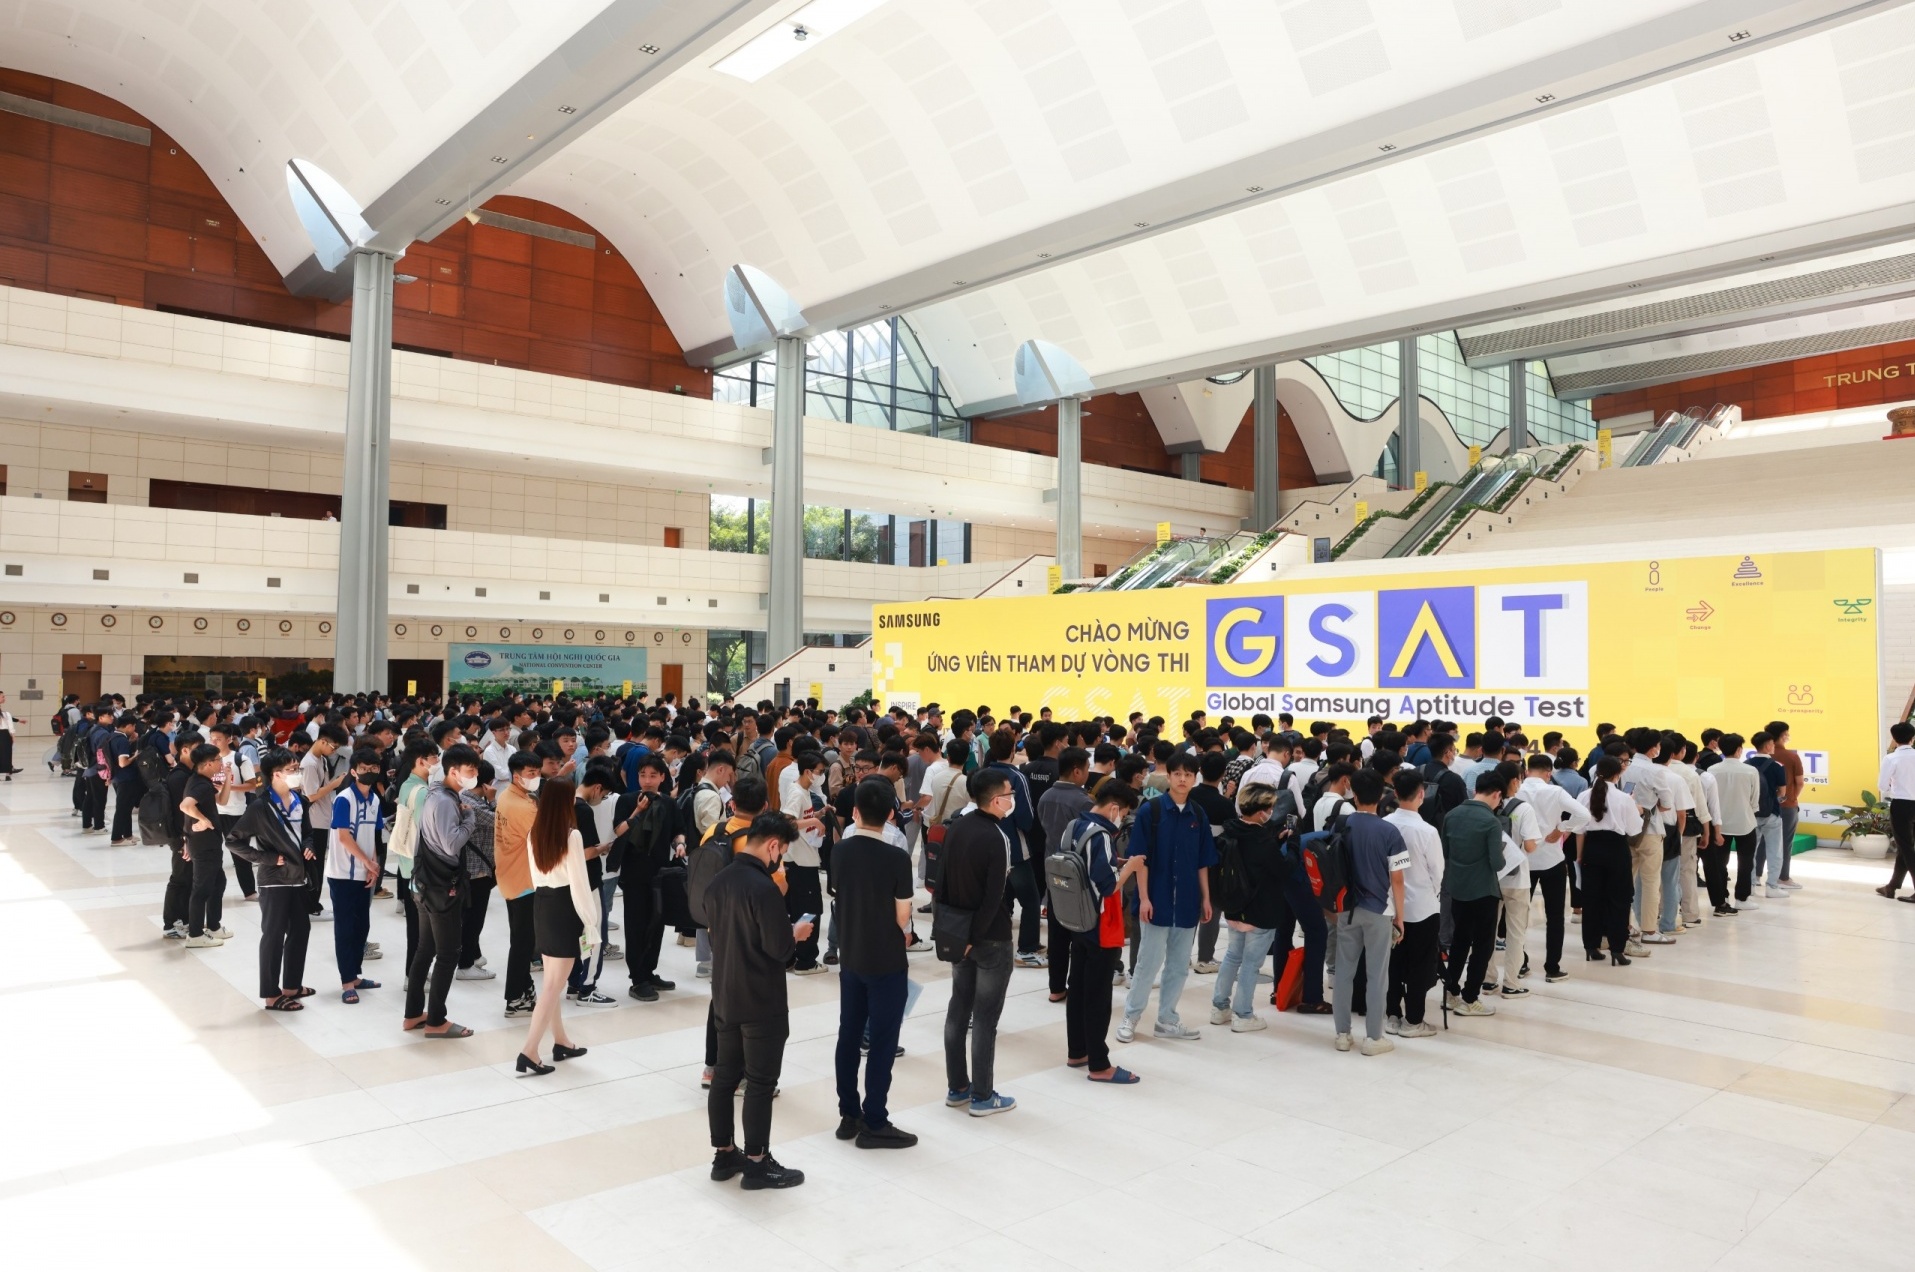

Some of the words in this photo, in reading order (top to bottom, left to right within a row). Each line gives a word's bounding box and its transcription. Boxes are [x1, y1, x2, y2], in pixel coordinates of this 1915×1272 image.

[1823, 366, 1899, 388] TRUNG
[879, 612, 941, 629] SAMSUNG
[1065, 619, 1121, 643] CHÀO
[1128, 616, 1190, 642] MỪNG
[500, 652, 526, 661] TRUNG
[529, 651, 544, 661] TÂM
[546, 651, 562, 662] HỘI
[564, 653, 583, 663] NGHỊ
[585, 652, 606, 663] QUỐC
[928, 651, 961, 673] ỨNG
[966, 650, 1002, 673] VIÊN
[1008, 653, 1055, 673] THAM
[1062, 653, 1086, 678] DỰ
[1092, 648, 1150, 673] VÒNG
[1158, 652, 1189, 672] THI
[890, 701, 916, 711] INSPIRE
[1207, 693, 1274, 711] Global
[1282, 693, 1391, 719] Samsung
[1399, 693, 1515, 719] Aptitude
[1528, 697, 1585, 718] Test
